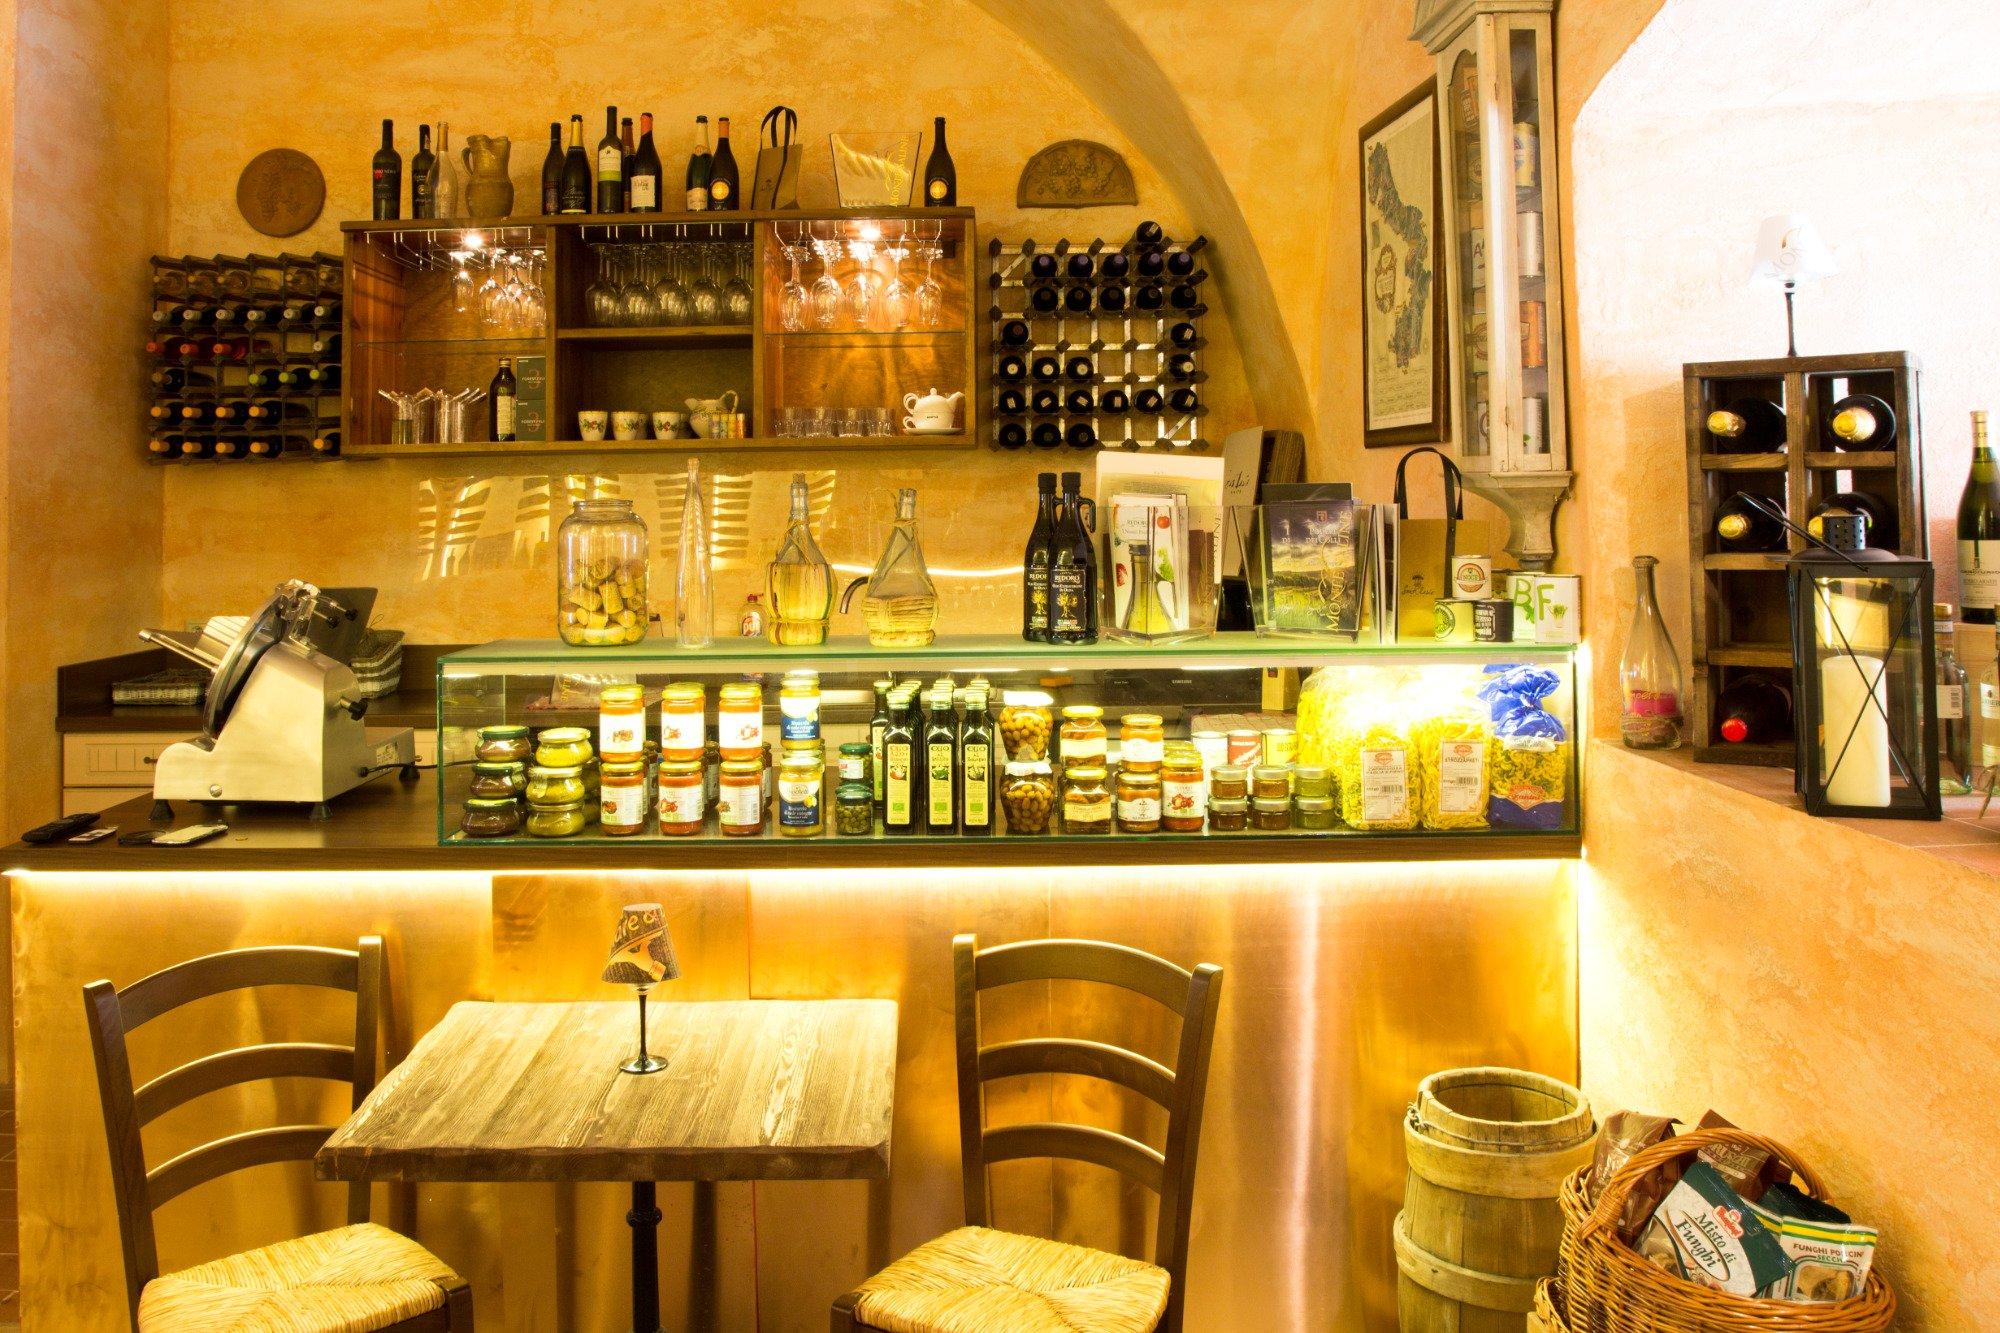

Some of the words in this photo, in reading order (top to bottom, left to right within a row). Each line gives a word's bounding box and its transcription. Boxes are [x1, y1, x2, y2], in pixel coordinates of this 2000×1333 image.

[1537, 584, 1554, 621] F
[1674, 1219, 1721, 1268] Funghi
[1695, 1213, 1727, 1249] Misto
[1723, 1252, 1737, 1264] di
[1793, 1243, 1828, 1255] FUNGHI
